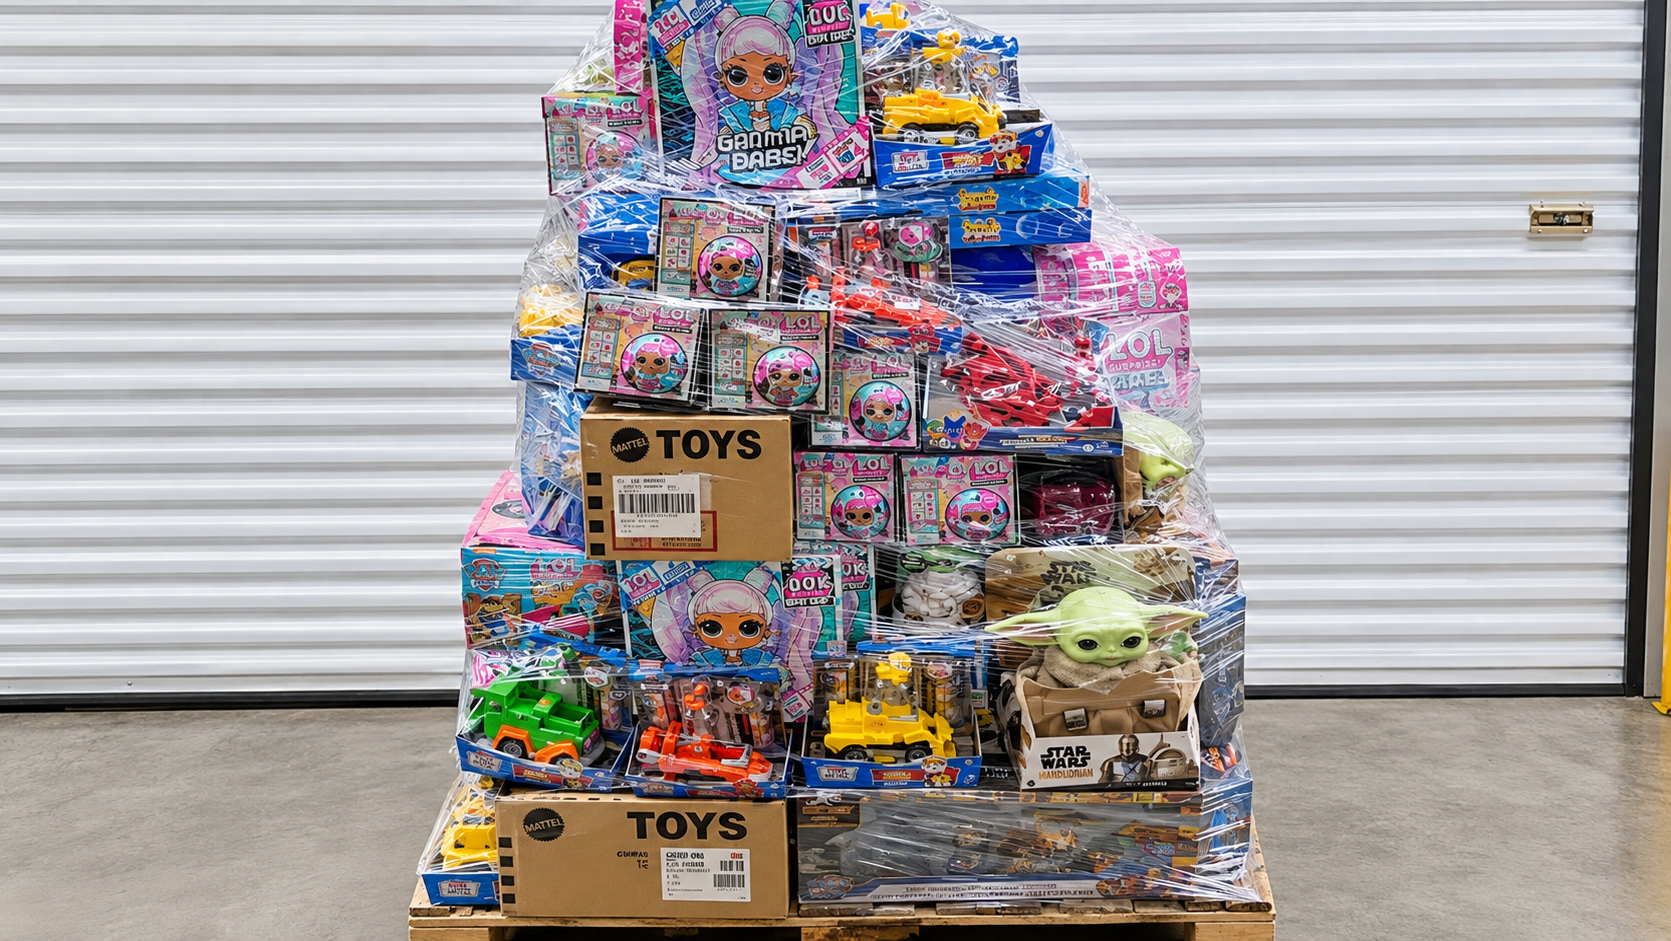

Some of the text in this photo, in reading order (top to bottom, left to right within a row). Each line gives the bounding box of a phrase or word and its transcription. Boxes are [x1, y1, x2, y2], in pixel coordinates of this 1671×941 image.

[1108, 329, 1174, 361] LOL
[611, 438, 649, 454] MATTEL
[656, 429, 762, 460] TOYS
[1040, 745, 1091, 758] STAR
[1040, 756, 1091, 770] WARS
[524, 818, 565, 833] MATTEL
[627, 811, 748, 840] TOYS
